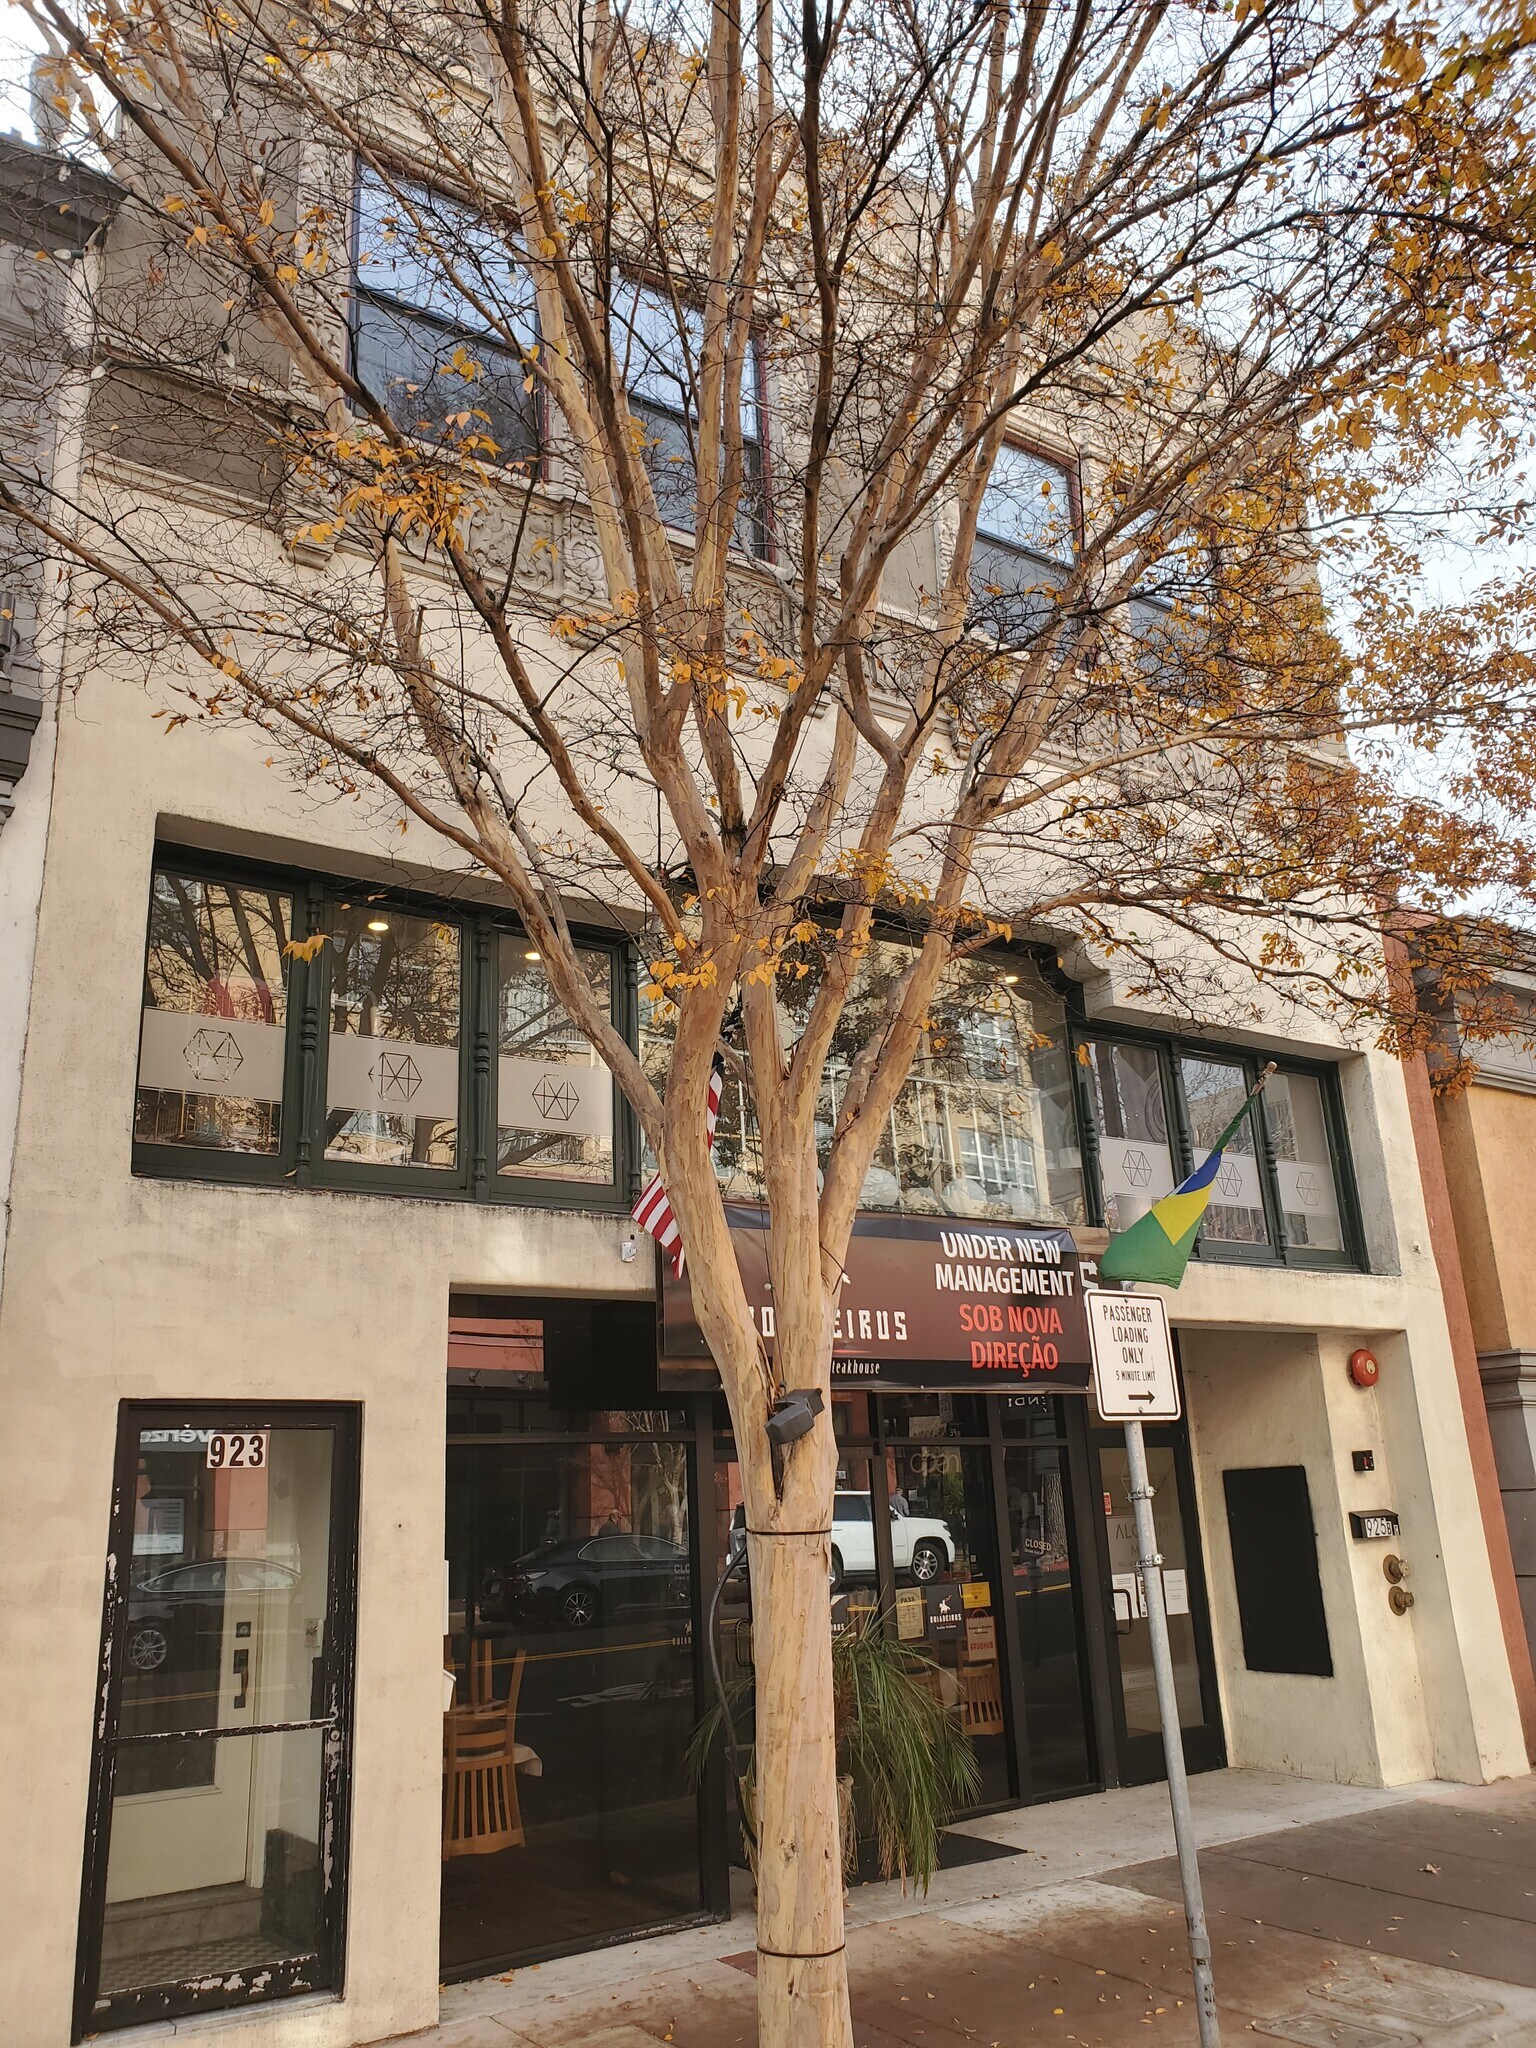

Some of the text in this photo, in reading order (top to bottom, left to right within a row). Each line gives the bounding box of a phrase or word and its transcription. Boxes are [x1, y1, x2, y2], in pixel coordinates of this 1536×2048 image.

[939, 1231, 1061, 1264] UNDER NEW
[935, 1263, 1074, 1296] MANAGEMENT
[959, 1303, 1064, 1334] SOB NOVA
[1103, 1305, 1152, 1323] PASSENGER
[1111, 1326, 1149, 1343] LOADING
[970, 1335, 1059, 1378] DIREÇÃO
[1122, 1347, 1145, 1364] ONLY
[1115, 1370, 1156, 1382] 5 MINUTE LIMIT
[210, 1435, 263, 1468] 923
[1025, 1538, 1051, 1551] CLOSED
[900, 1596, 915, 1604] PASS
